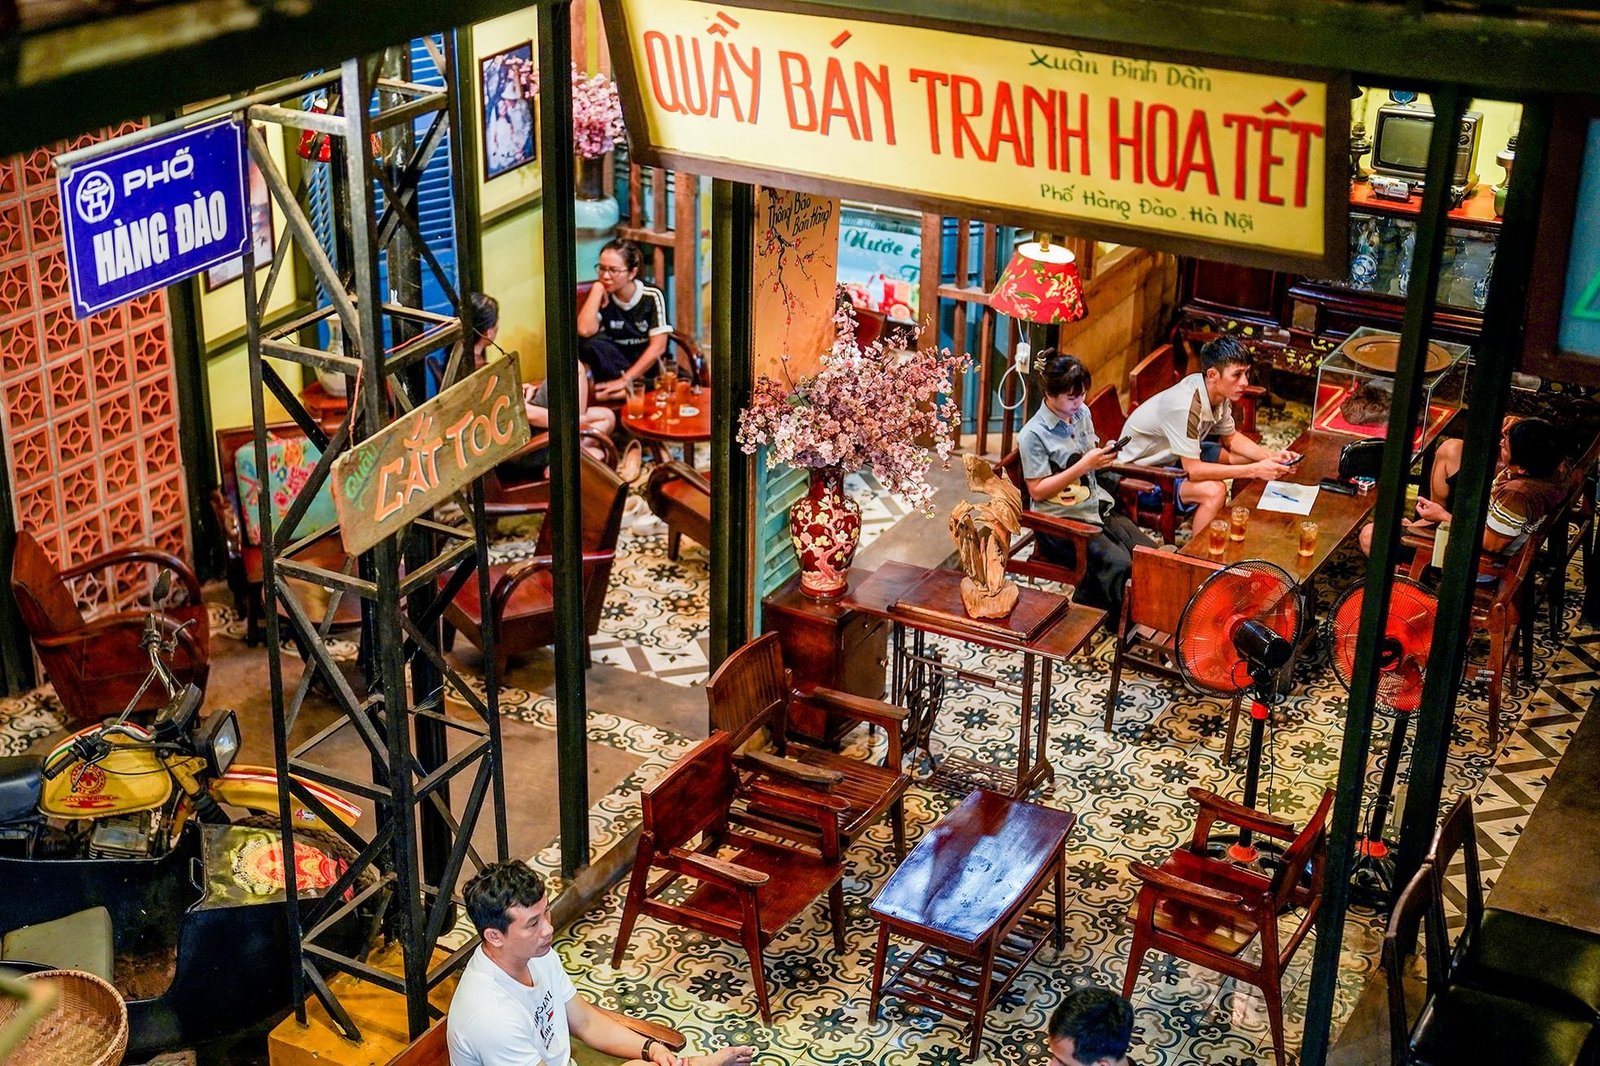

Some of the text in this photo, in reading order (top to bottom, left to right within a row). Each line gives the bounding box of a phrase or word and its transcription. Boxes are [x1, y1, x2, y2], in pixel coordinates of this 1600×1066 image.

[643, 11, 1324, 208] QUẦY BÁN TRANH HOA TẾT
[122, 146, 195, 198] PHỐ
[794, 192, 811, 214] Báo
[1041, 184, 1254, 233] Phố Hàng Đào Hà Nội
[92, 190, 228, 286] HÀNG ĐÀO
[375, 375, 514, 522] CẮT TÓC
